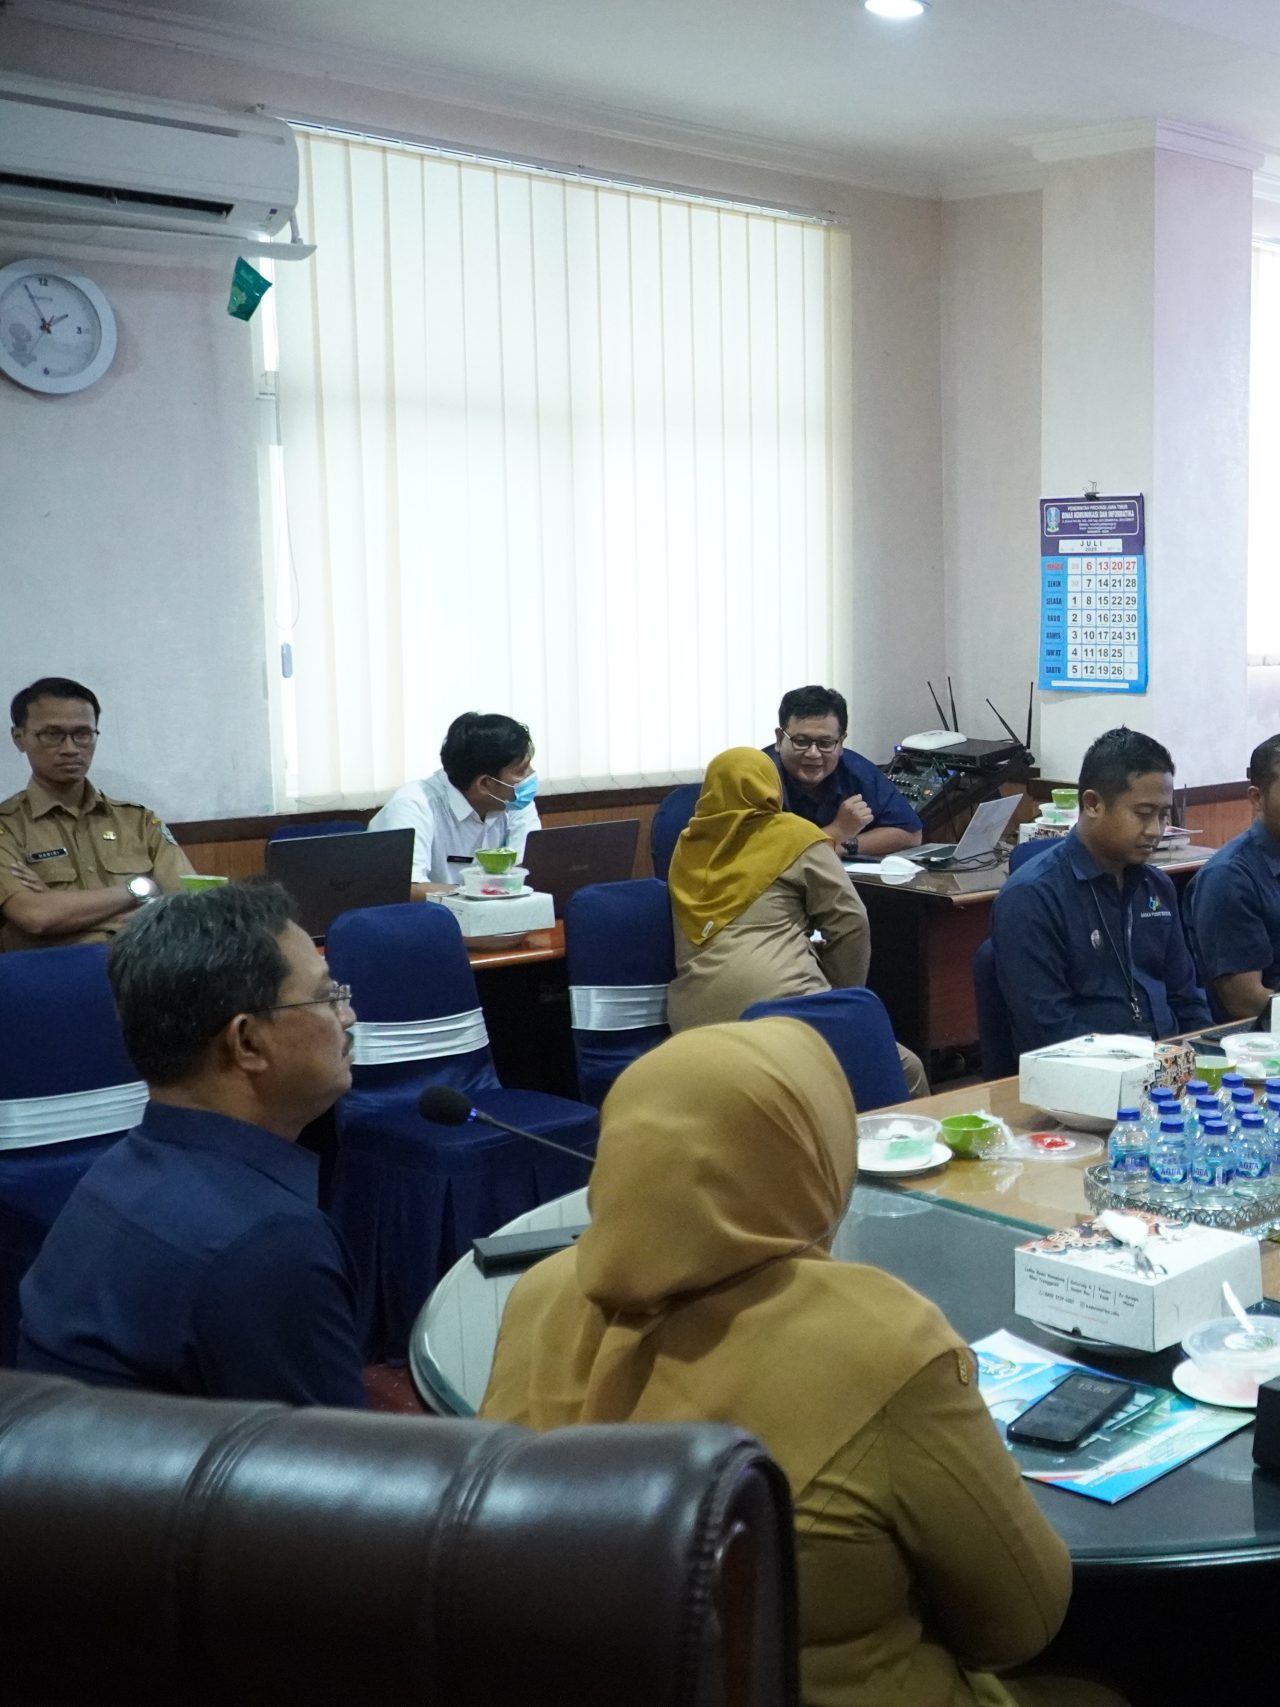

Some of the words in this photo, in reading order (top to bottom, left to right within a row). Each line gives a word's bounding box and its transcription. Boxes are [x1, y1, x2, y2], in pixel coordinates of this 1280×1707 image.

[1087, 562, 1092, 570] 6
[1098, 561, 1109, 570] 13
[1112, 561, 1122, 570] 20
[1126, 561, 1136, 570] 27
[1086, 579, 1091, 587] 7
[1098, 579, 1108, 587] 14
[1112, 579, 1121, 587] 21
[1126, 578, 1136, 587] 28
[1072, 596, 1076, 604] 1
[1086, 596, 1091, 605] 8
[1098, 596, 1108, 605] 15
[1112, 596, 1122, 605] 22
[1126, 596, 1136, 605] 29
[1072, 613, 1077, 622] 2
[1086, 614, 1092, 622] 9
[1098, 614, 1108, 622] 16
[1112, 614, 1122, 623] 23
[1126, 614, 1136, 623] 30
[1072, 631, 1077, 639] 3
[1084, 631, 1094, 639] 10
[1098, 631, 1108, 640] 17
[1112, 631, 1122, 640] 24
[1126, 632, 1135, 640] 31
[1072, 648, 1077, 656] 4
[1084, 648, 1093, 656] 11
[1098, 649, 1108, 657] 18
[1112, 649, 1122, 657] 25
[1072, 665, 1077, 673] 5
[1084, 666, 1094, 674] 12
[1098, 666, 1108, 675] 19
[1111, 666, 1122, 675] 26
[1161, 1168, 1182, 1176] AQUA
